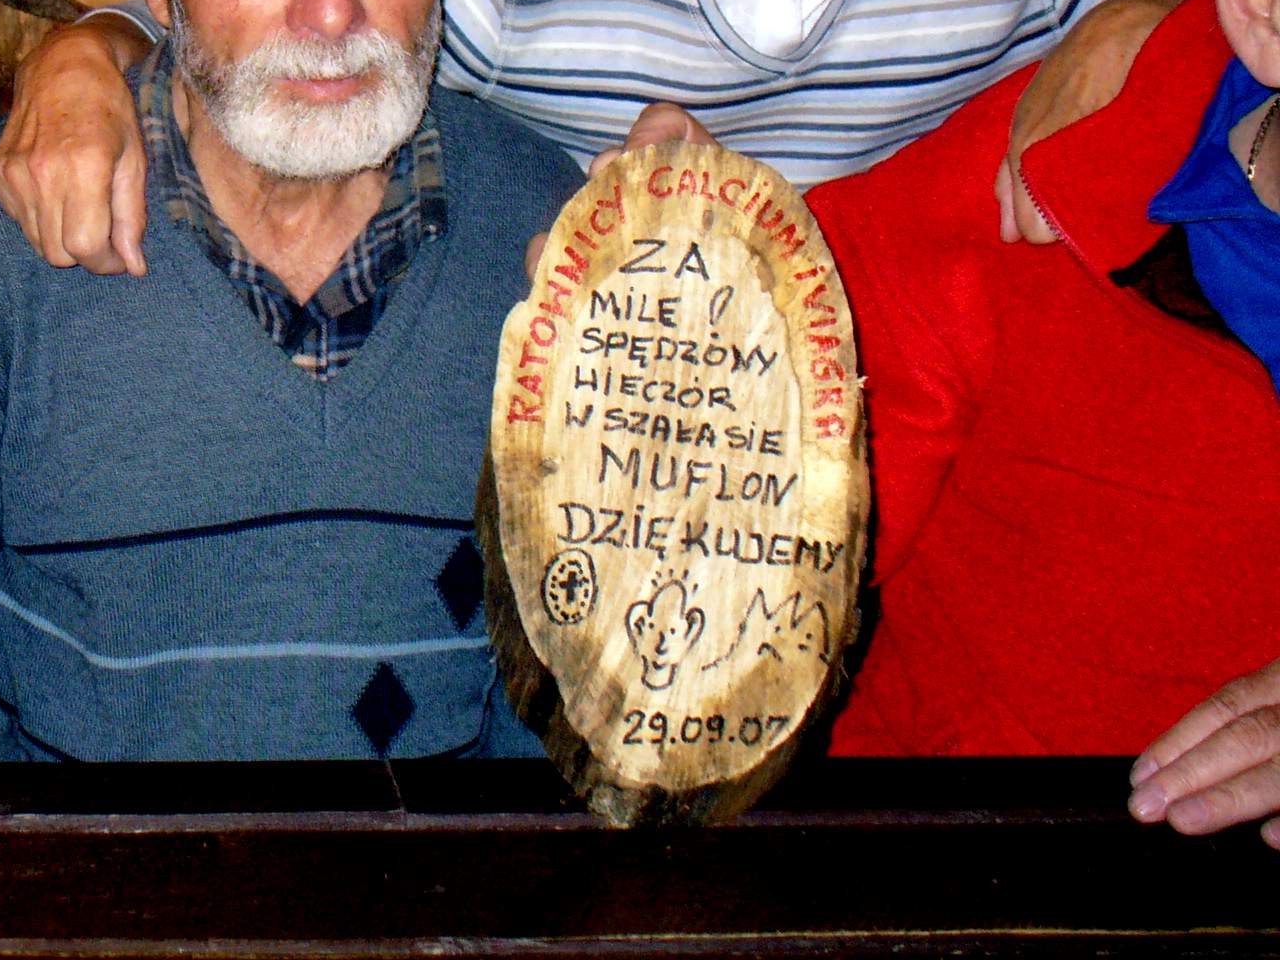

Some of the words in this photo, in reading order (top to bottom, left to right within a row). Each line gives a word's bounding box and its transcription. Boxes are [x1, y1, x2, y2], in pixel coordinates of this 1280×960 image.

[618, 239, 711, 281] ZA
[508, 183, 627, 425] RATOWNICY
[647, 165, 806, 261] CALCIUM
[802, 283, 848, 440] VIAGRA
[574, 365, 738, 412] WIECZÓR
[598, 442, 799, 507] MUFLON
[557, 502, 845, 574] DZIĘKUJEMY
[622, 709, 790, 746] 29.09.07
